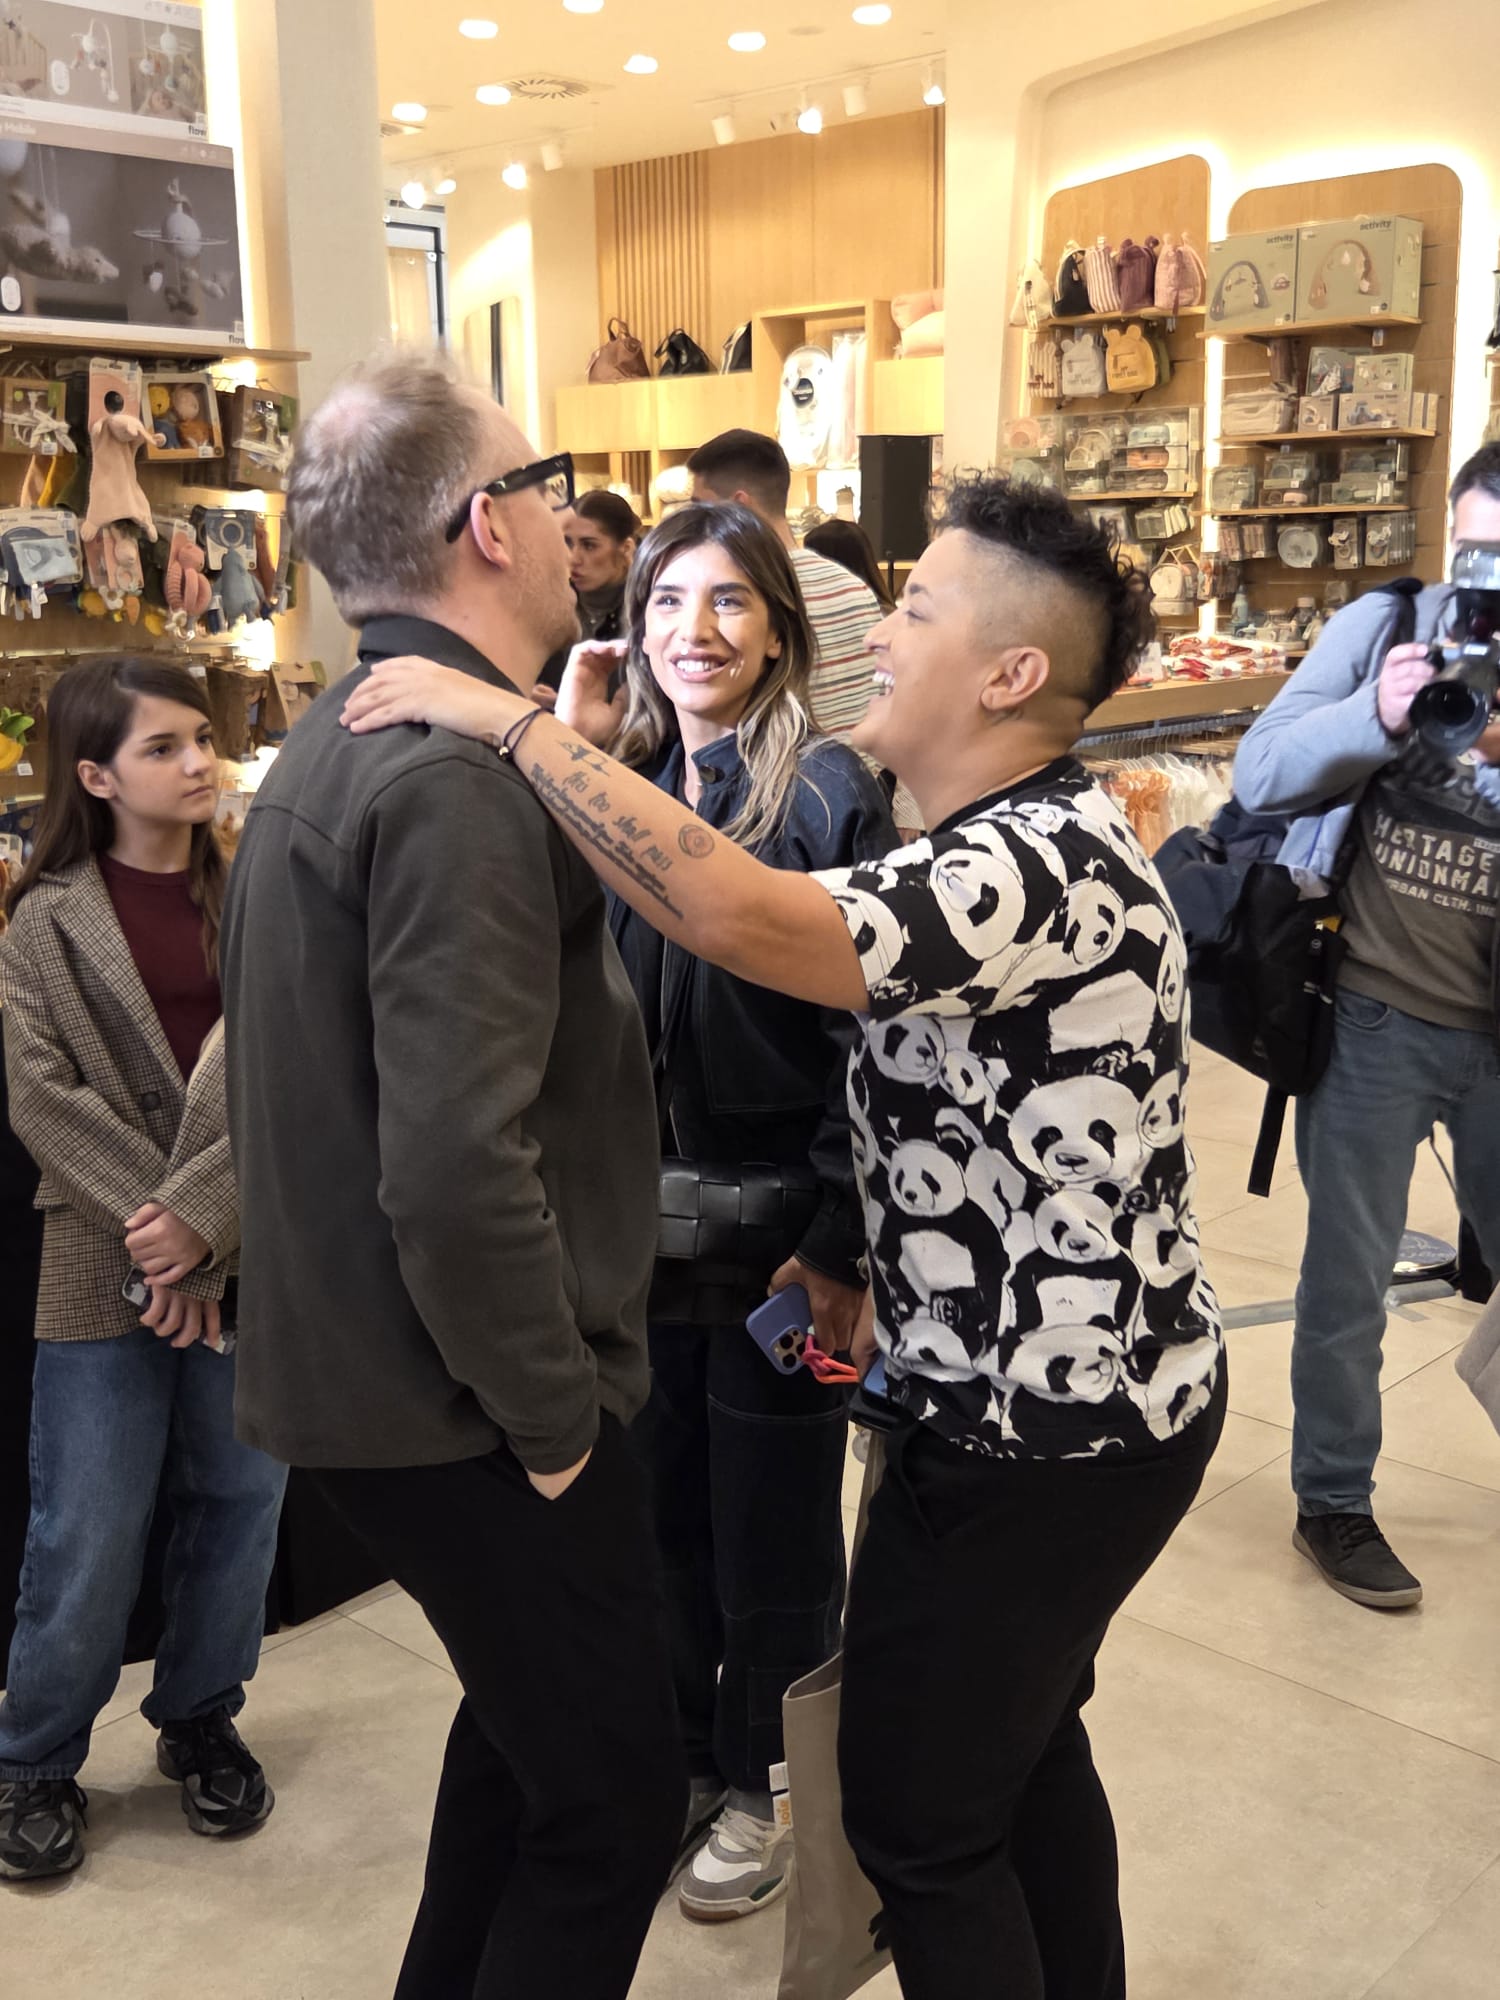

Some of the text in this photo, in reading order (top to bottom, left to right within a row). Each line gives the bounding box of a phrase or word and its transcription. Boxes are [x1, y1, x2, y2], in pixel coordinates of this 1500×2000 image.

[1266, 233, 1295, 244] activity
[1360, 219, 1392, 231] activity
[612, 815, 652, 842] shall
[640, 845, 673, 872] pass
[1375, 843, 1500, 898] UNIONMA
